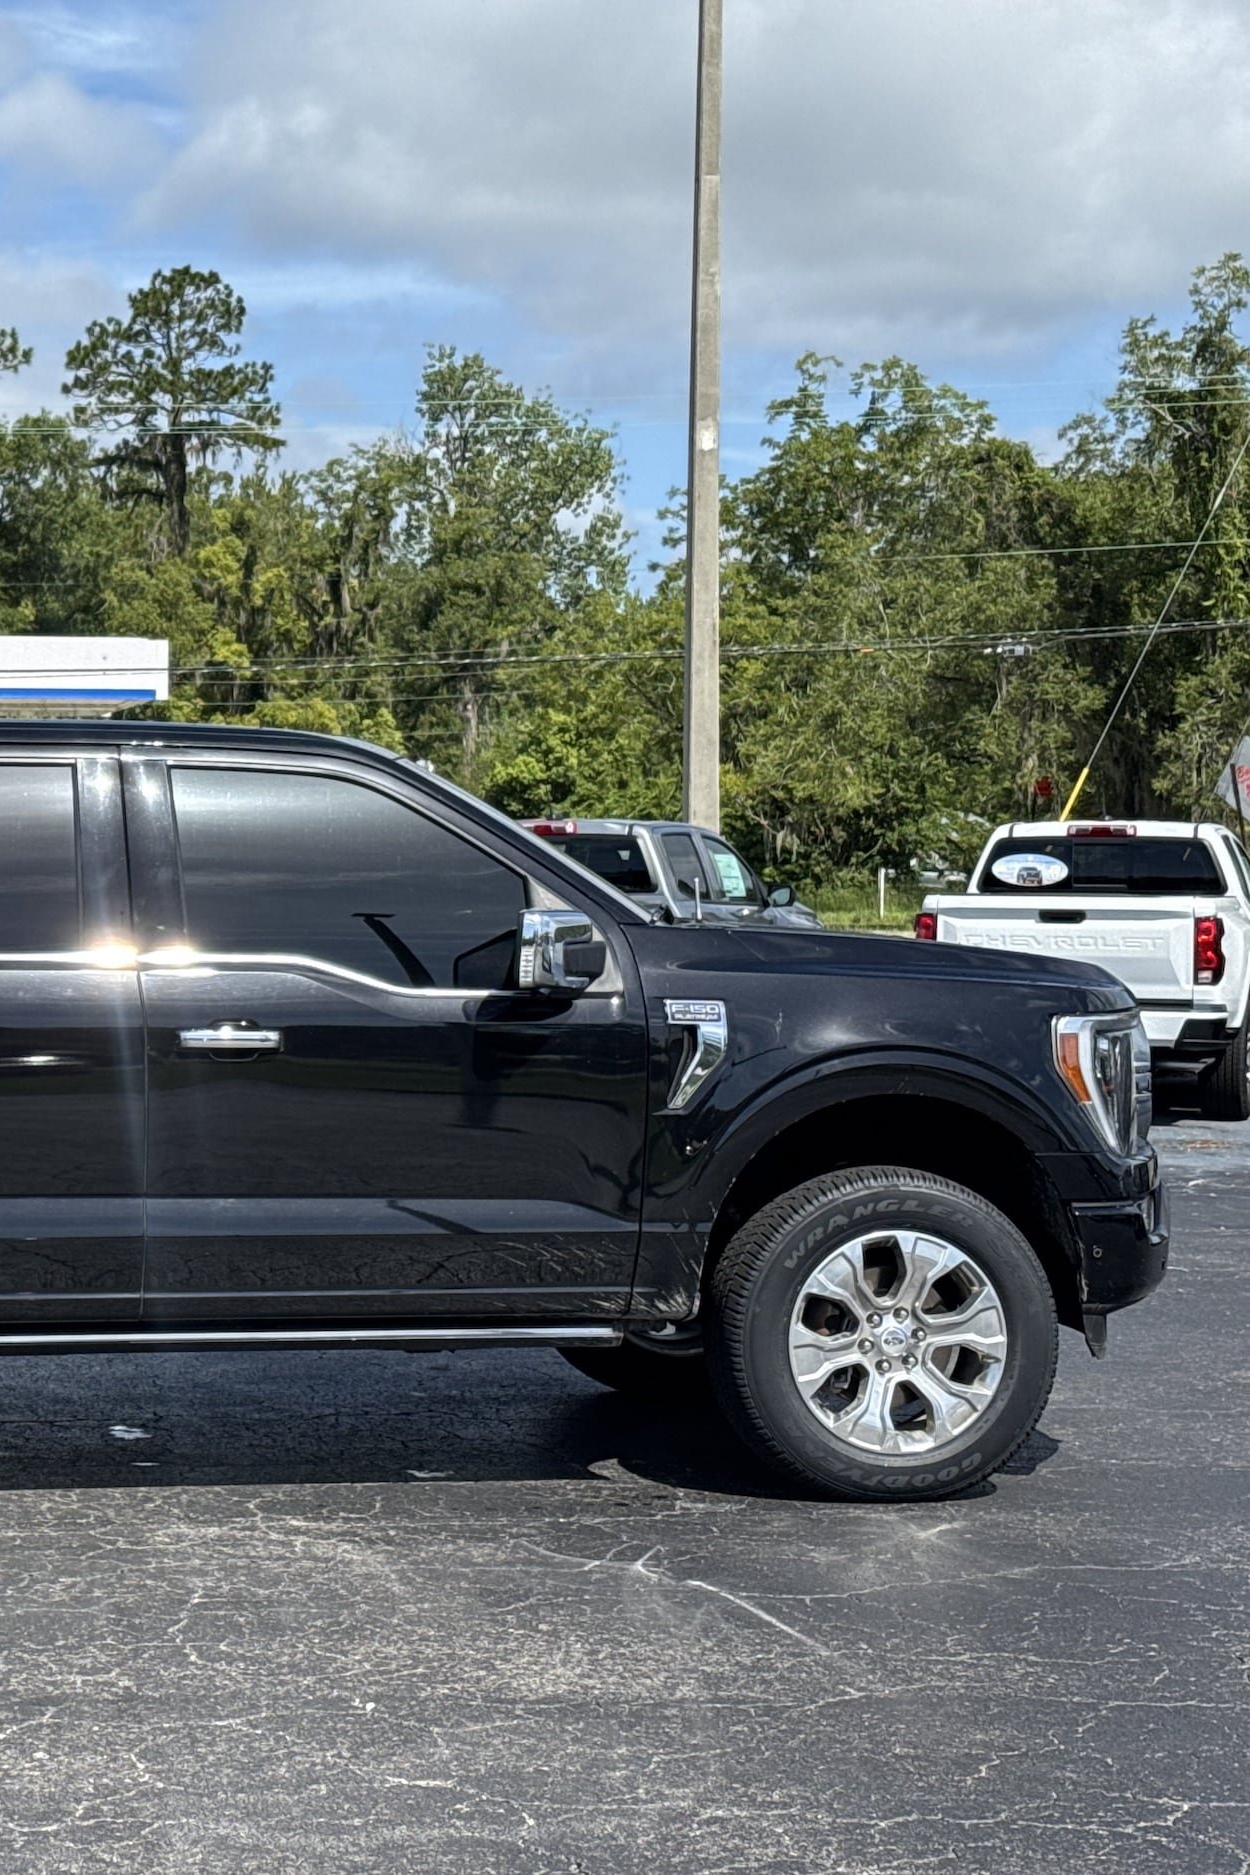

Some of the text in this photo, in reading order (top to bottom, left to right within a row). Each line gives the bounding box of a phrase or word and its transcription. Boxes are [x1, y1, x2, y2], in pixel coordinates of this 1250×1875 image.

[962, 933, 1165, 950] CHEVROLET
[671, 1004, 720, 1014] F-150
[782, 1198, 975, 1271] WRANGLER
[781, 1416, 983, 1488] GOODYEAR
